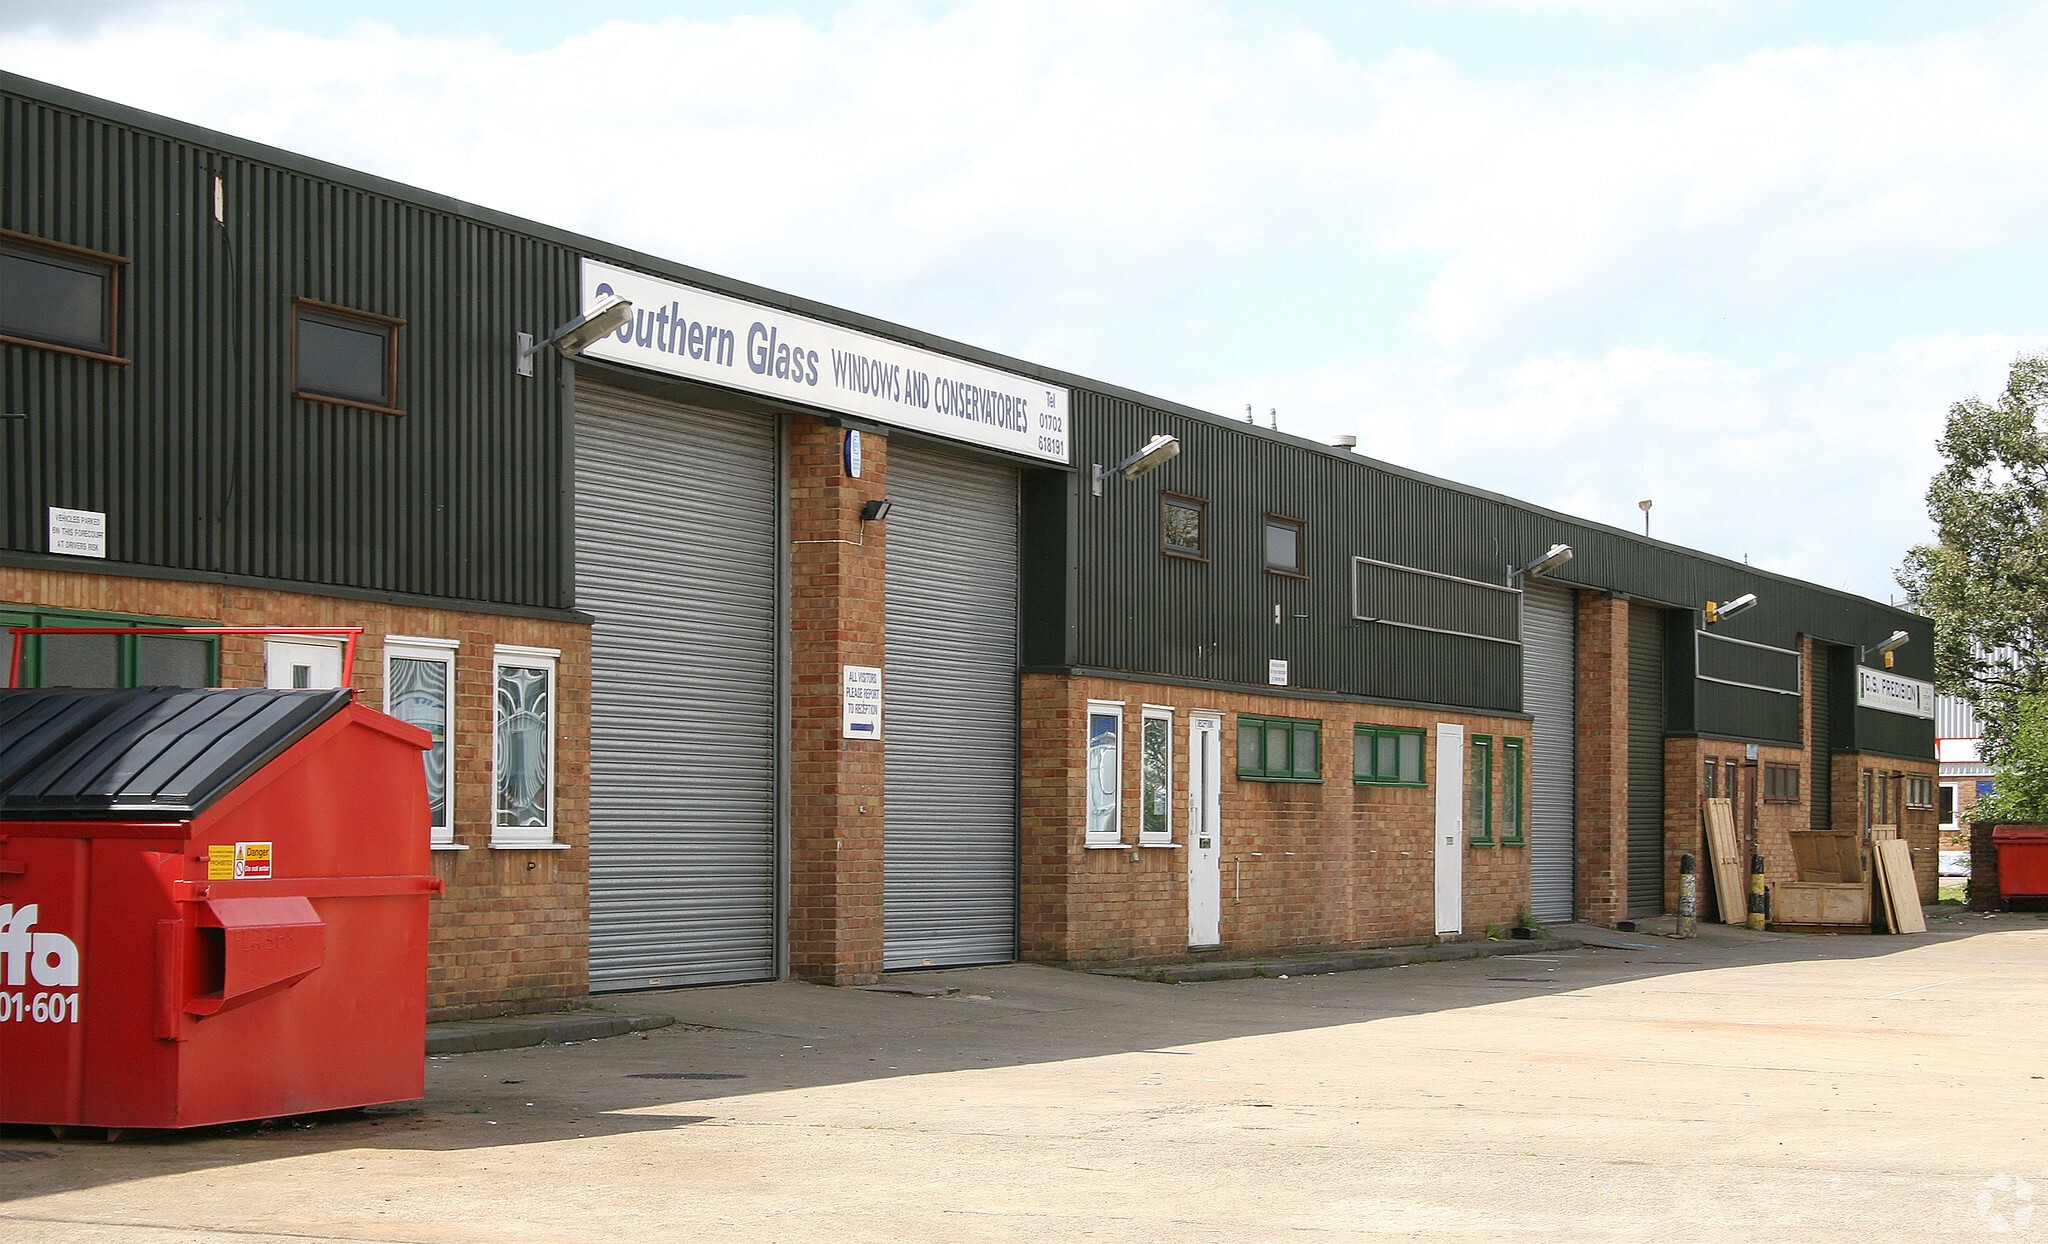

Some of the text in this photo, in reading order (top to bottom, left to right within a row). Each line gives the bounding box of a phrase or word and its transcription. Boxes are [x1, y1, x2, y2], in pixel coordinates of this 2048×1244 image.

[747, 322, 819, 386] Glass
[831, 348, 900, 402] WINDOWS
[904, 369, 930, 410] AND
[934, 376, 1028, 434] CONSERVATORIES
[1046, 391, 1056, 408] Tel
[1040, 412, 1062, 432] 01702
[1038, 435, 1064, 456] 618191
[81, 517, 100, 526] PARKED
[62, 528, 74, 536] THIS
[66, 541, 87, 550] DRIVERS
[88, 544, 100, 552] RISK
[848, 672, 877, 684] ALL VISITORS
[846, 687, 880, 700] PLEASE REPORT
[848, 703, 854, 714] TO
[247, 848, 269, 858] Danger
